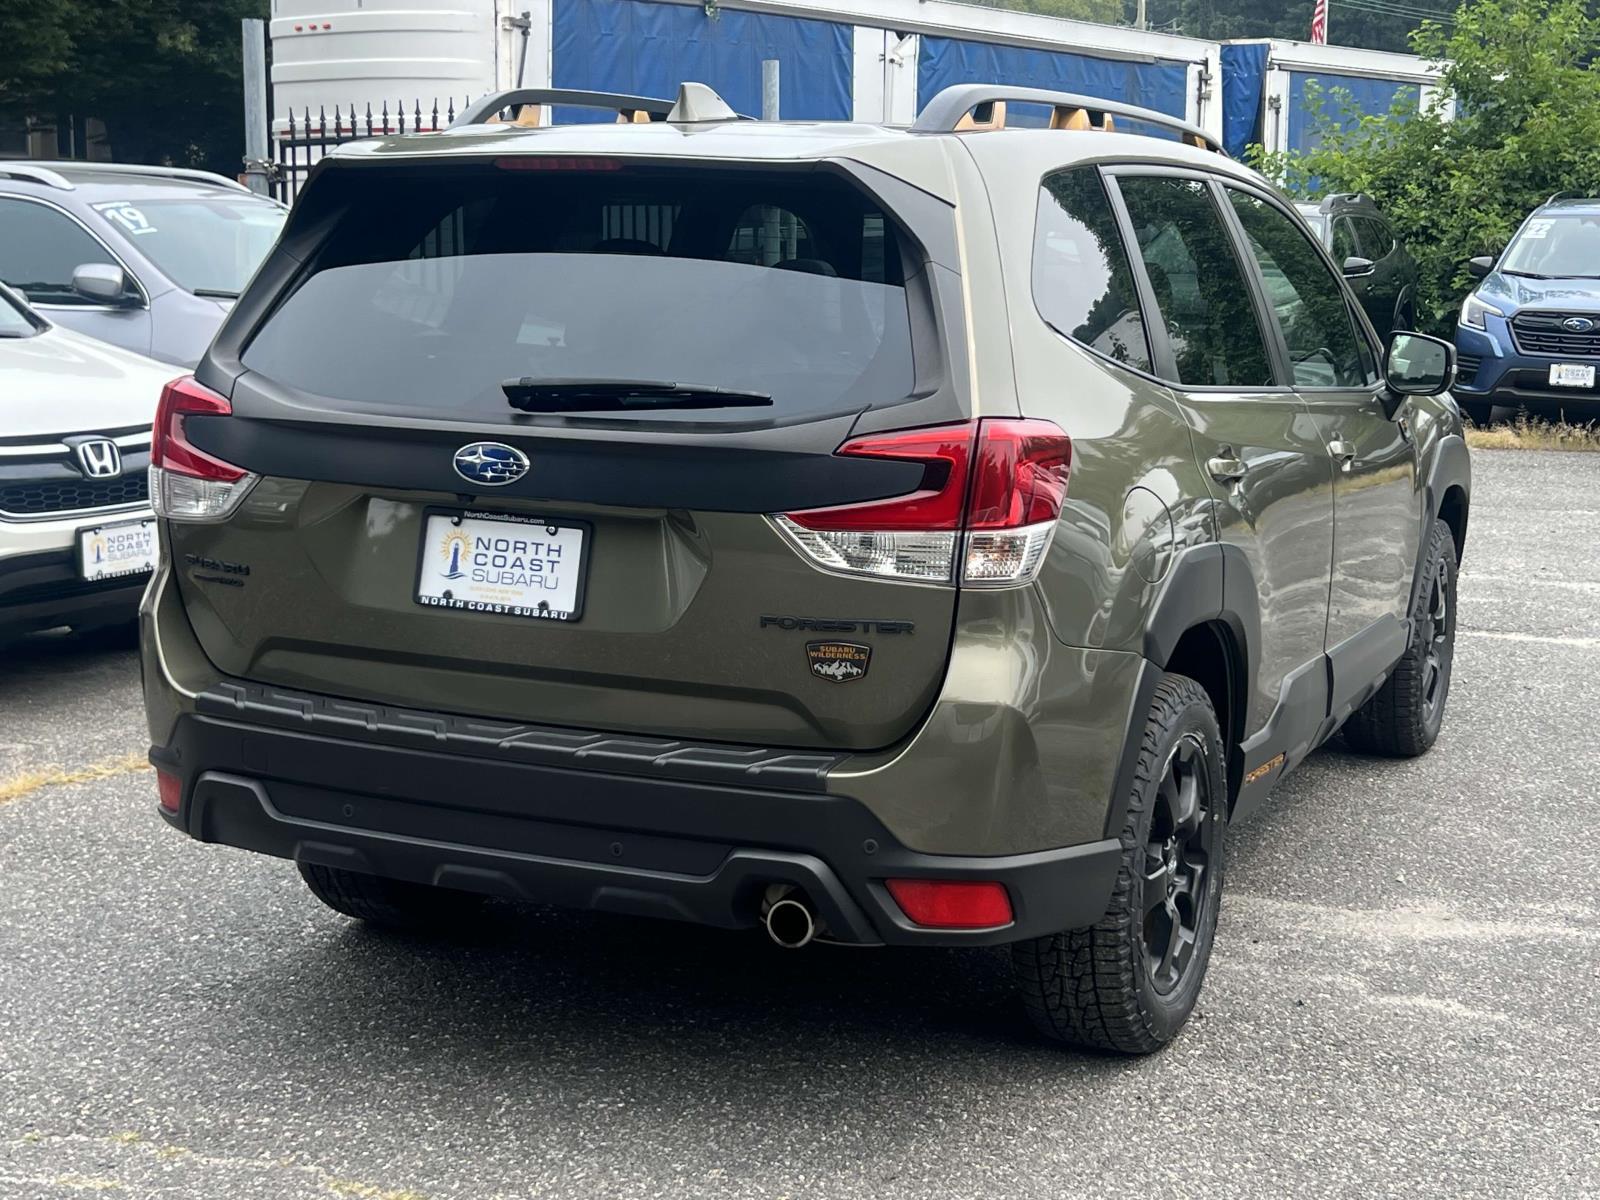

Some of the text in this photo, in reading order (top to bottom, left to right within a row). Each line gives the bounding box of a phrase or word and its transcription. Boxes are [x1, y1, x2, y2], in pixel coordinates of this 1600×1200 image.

[103, 207, 150, 229] 19
[463, 510, 546, 525] NorthCoastSubaru.com
[107, 531, 151, 544] NORTH
[107, 540, 151, 553] COAST
[475, 536, 563, 558] NORTH
[473, 552, 561, 574] COAST
[471, 568, 559, 590] SUBARU
[420, 595, 465, 609] NORTH
[467, 601, 511, 614] COAST
[514, 606, 569, 621] SUBARU
[759, 615, 915, 635] FORESTER
[809, 651, 866, 660] WILDERNESS
[819, 645, 856, 654] SUBARU
